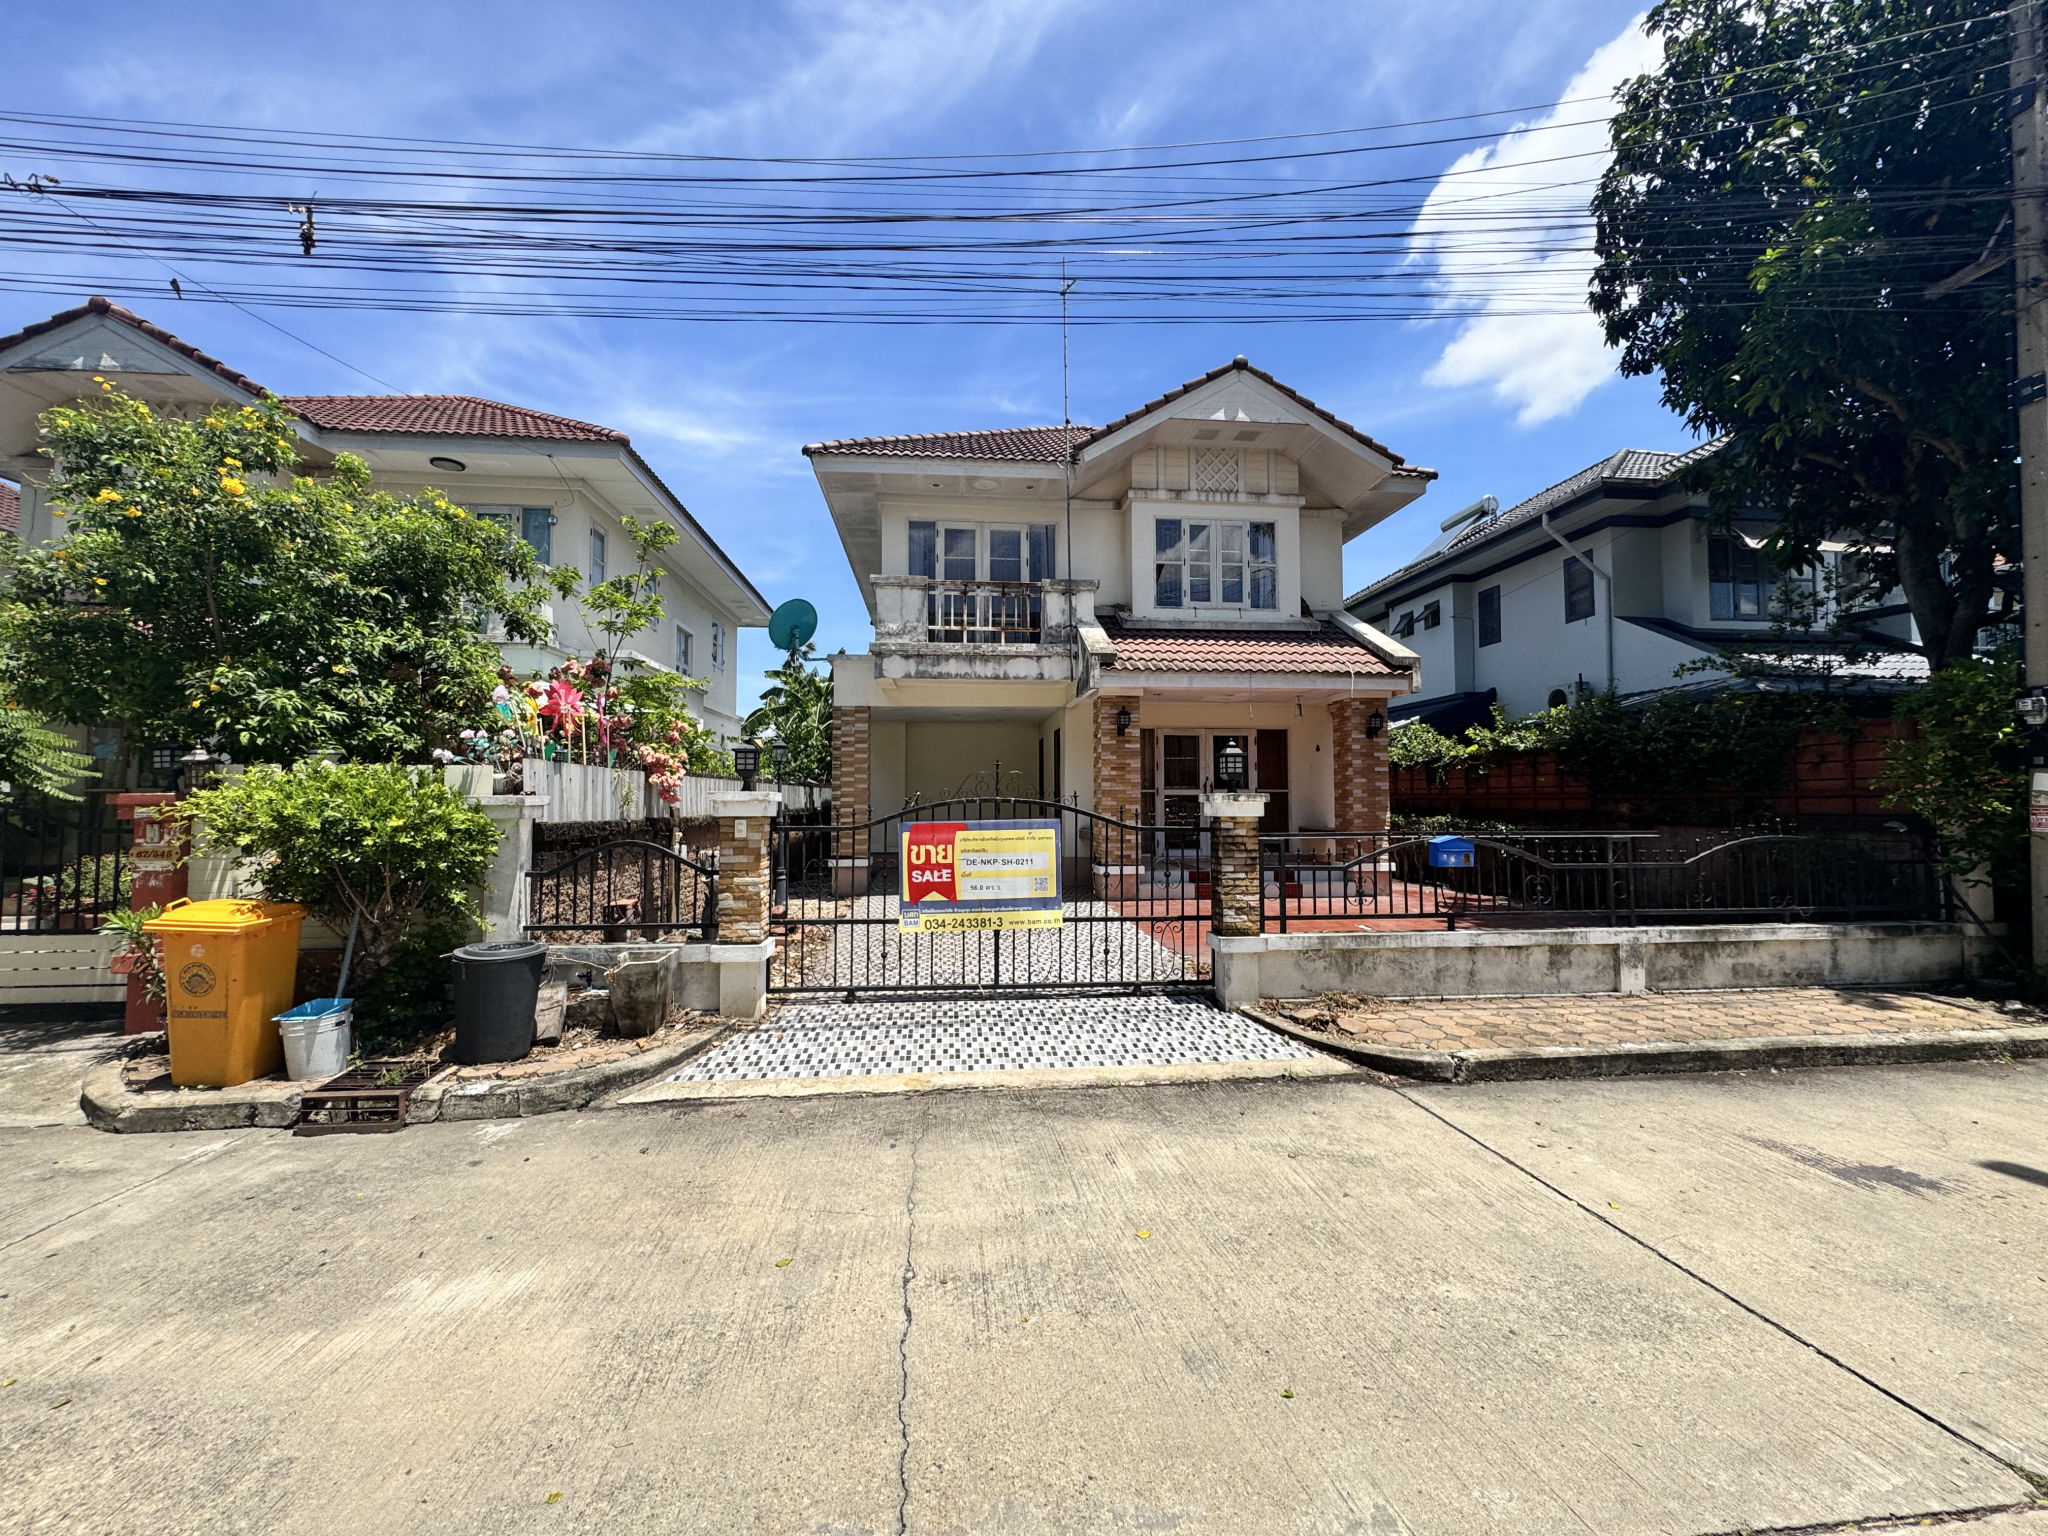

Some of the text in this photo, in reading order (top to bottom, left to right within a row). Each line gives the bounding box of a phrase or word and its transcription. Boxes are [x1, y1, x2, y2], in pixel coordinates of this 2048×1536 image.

[911, 844, 952, 864] ขาย
[966, 858, 1034, 866] DE-NKP-SH-0211
[911, 869, 952, 883] SALE
[924, 916, 1003, 930] 034-243381-3
